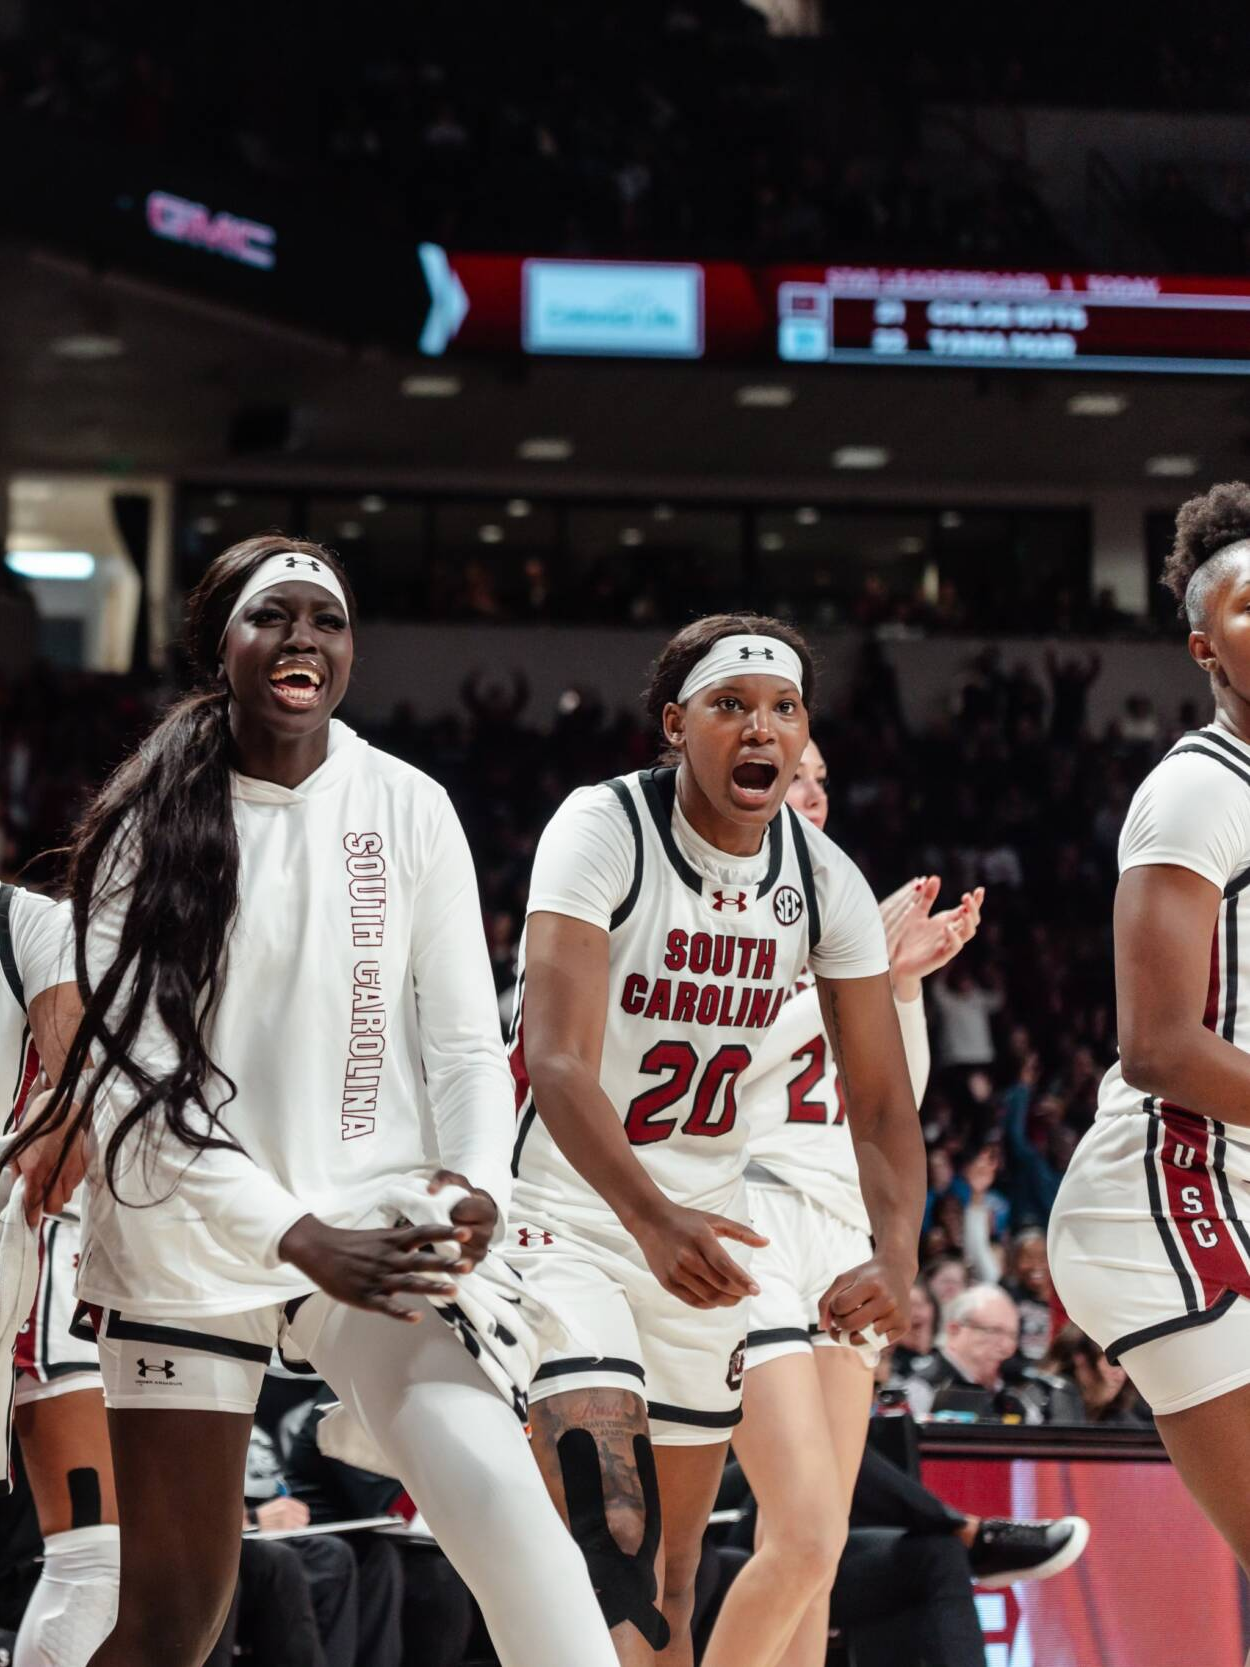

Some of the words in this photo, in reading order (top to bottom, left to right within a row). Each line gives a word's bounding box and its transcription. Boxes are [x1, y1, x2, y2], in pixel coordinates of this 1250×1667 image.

[146, 189, 276, 271] GMC
[343, 832, 386, 947] SOUTH
[775, 888, 801, 924] SEC
[664, 928, 777, 980] SOUTH
[342, 960, 386, 1141] CAROLINA
[624, 1040, 752, 1146] 20
[785, 1034, 847, 1126] 2
